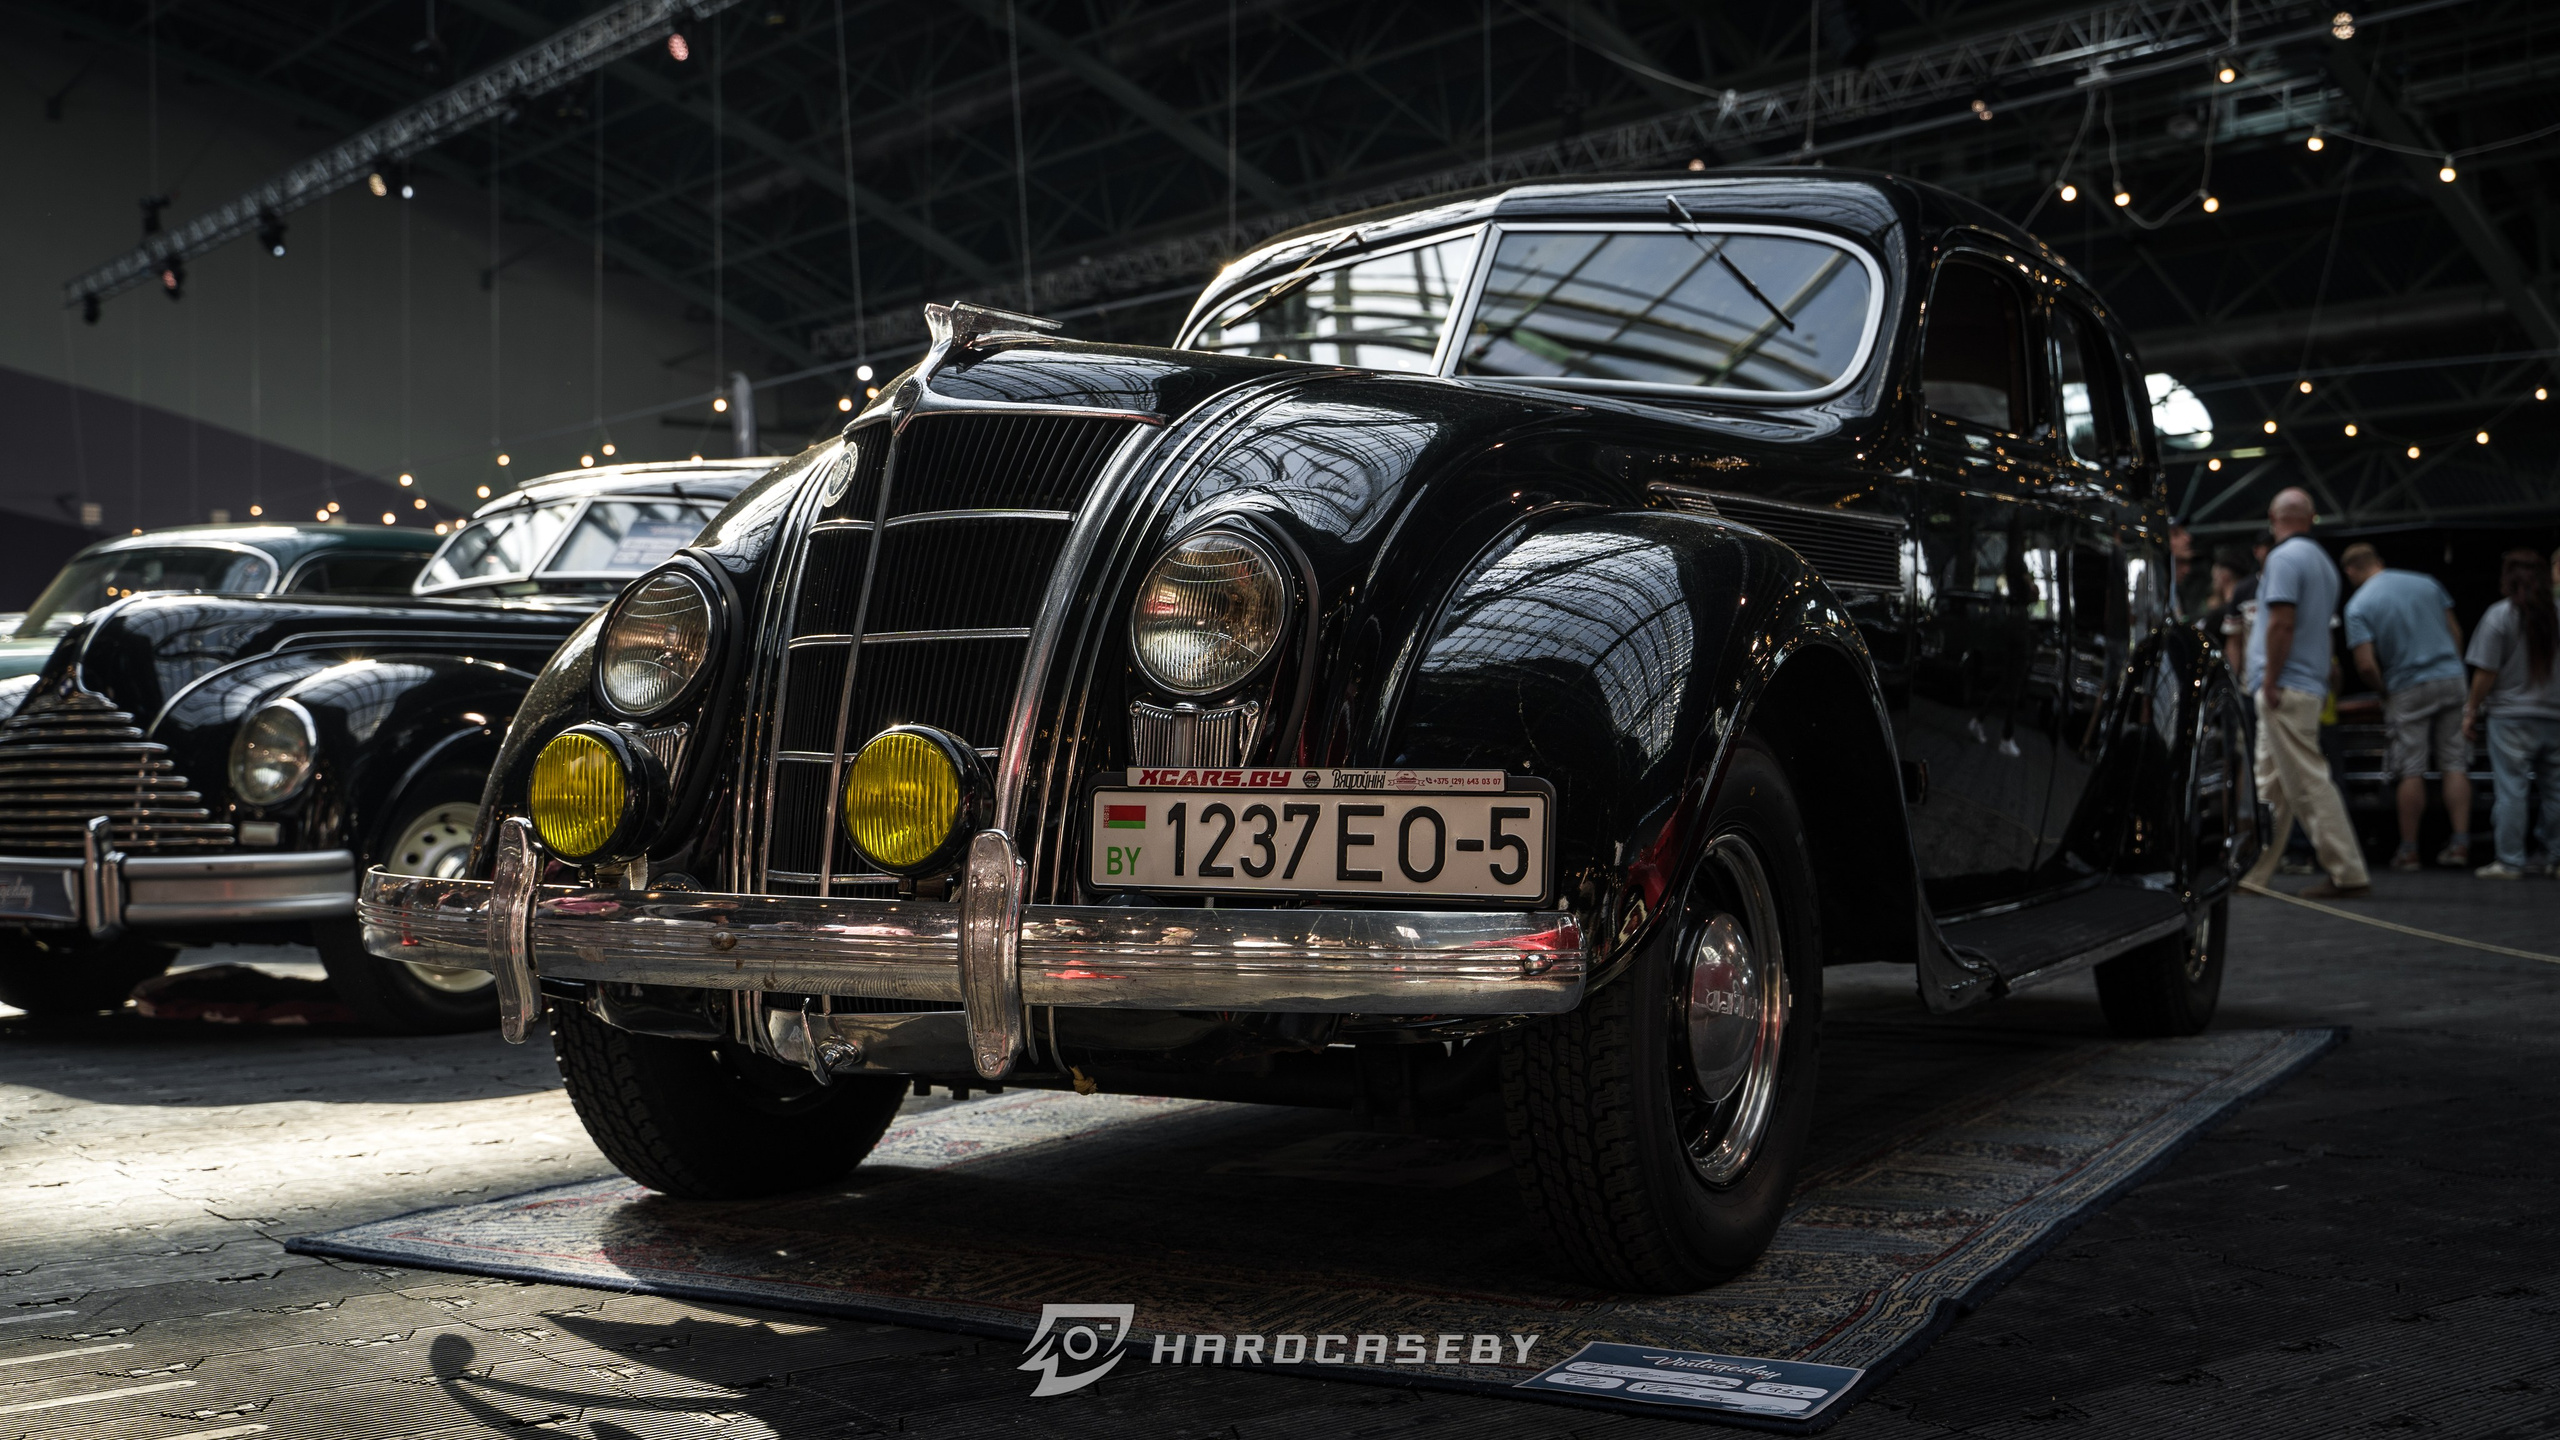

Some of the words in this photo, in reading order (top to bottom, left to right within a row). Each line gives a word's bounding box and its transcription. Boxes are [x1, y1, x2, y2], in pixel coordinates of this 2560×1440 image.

[1139, 769, 1292, 787] XCARS.BY
[1434, 777, 1449, 785] +375
[1451, 777, 1465, 786] (29)
[1167, 802, 1321, 880] 1237
[1336, 804, 1531, 885] EO-5
[1106, 846, 1142, 876] BY
[1643, 1355, 1782, 1380] Vintageday
